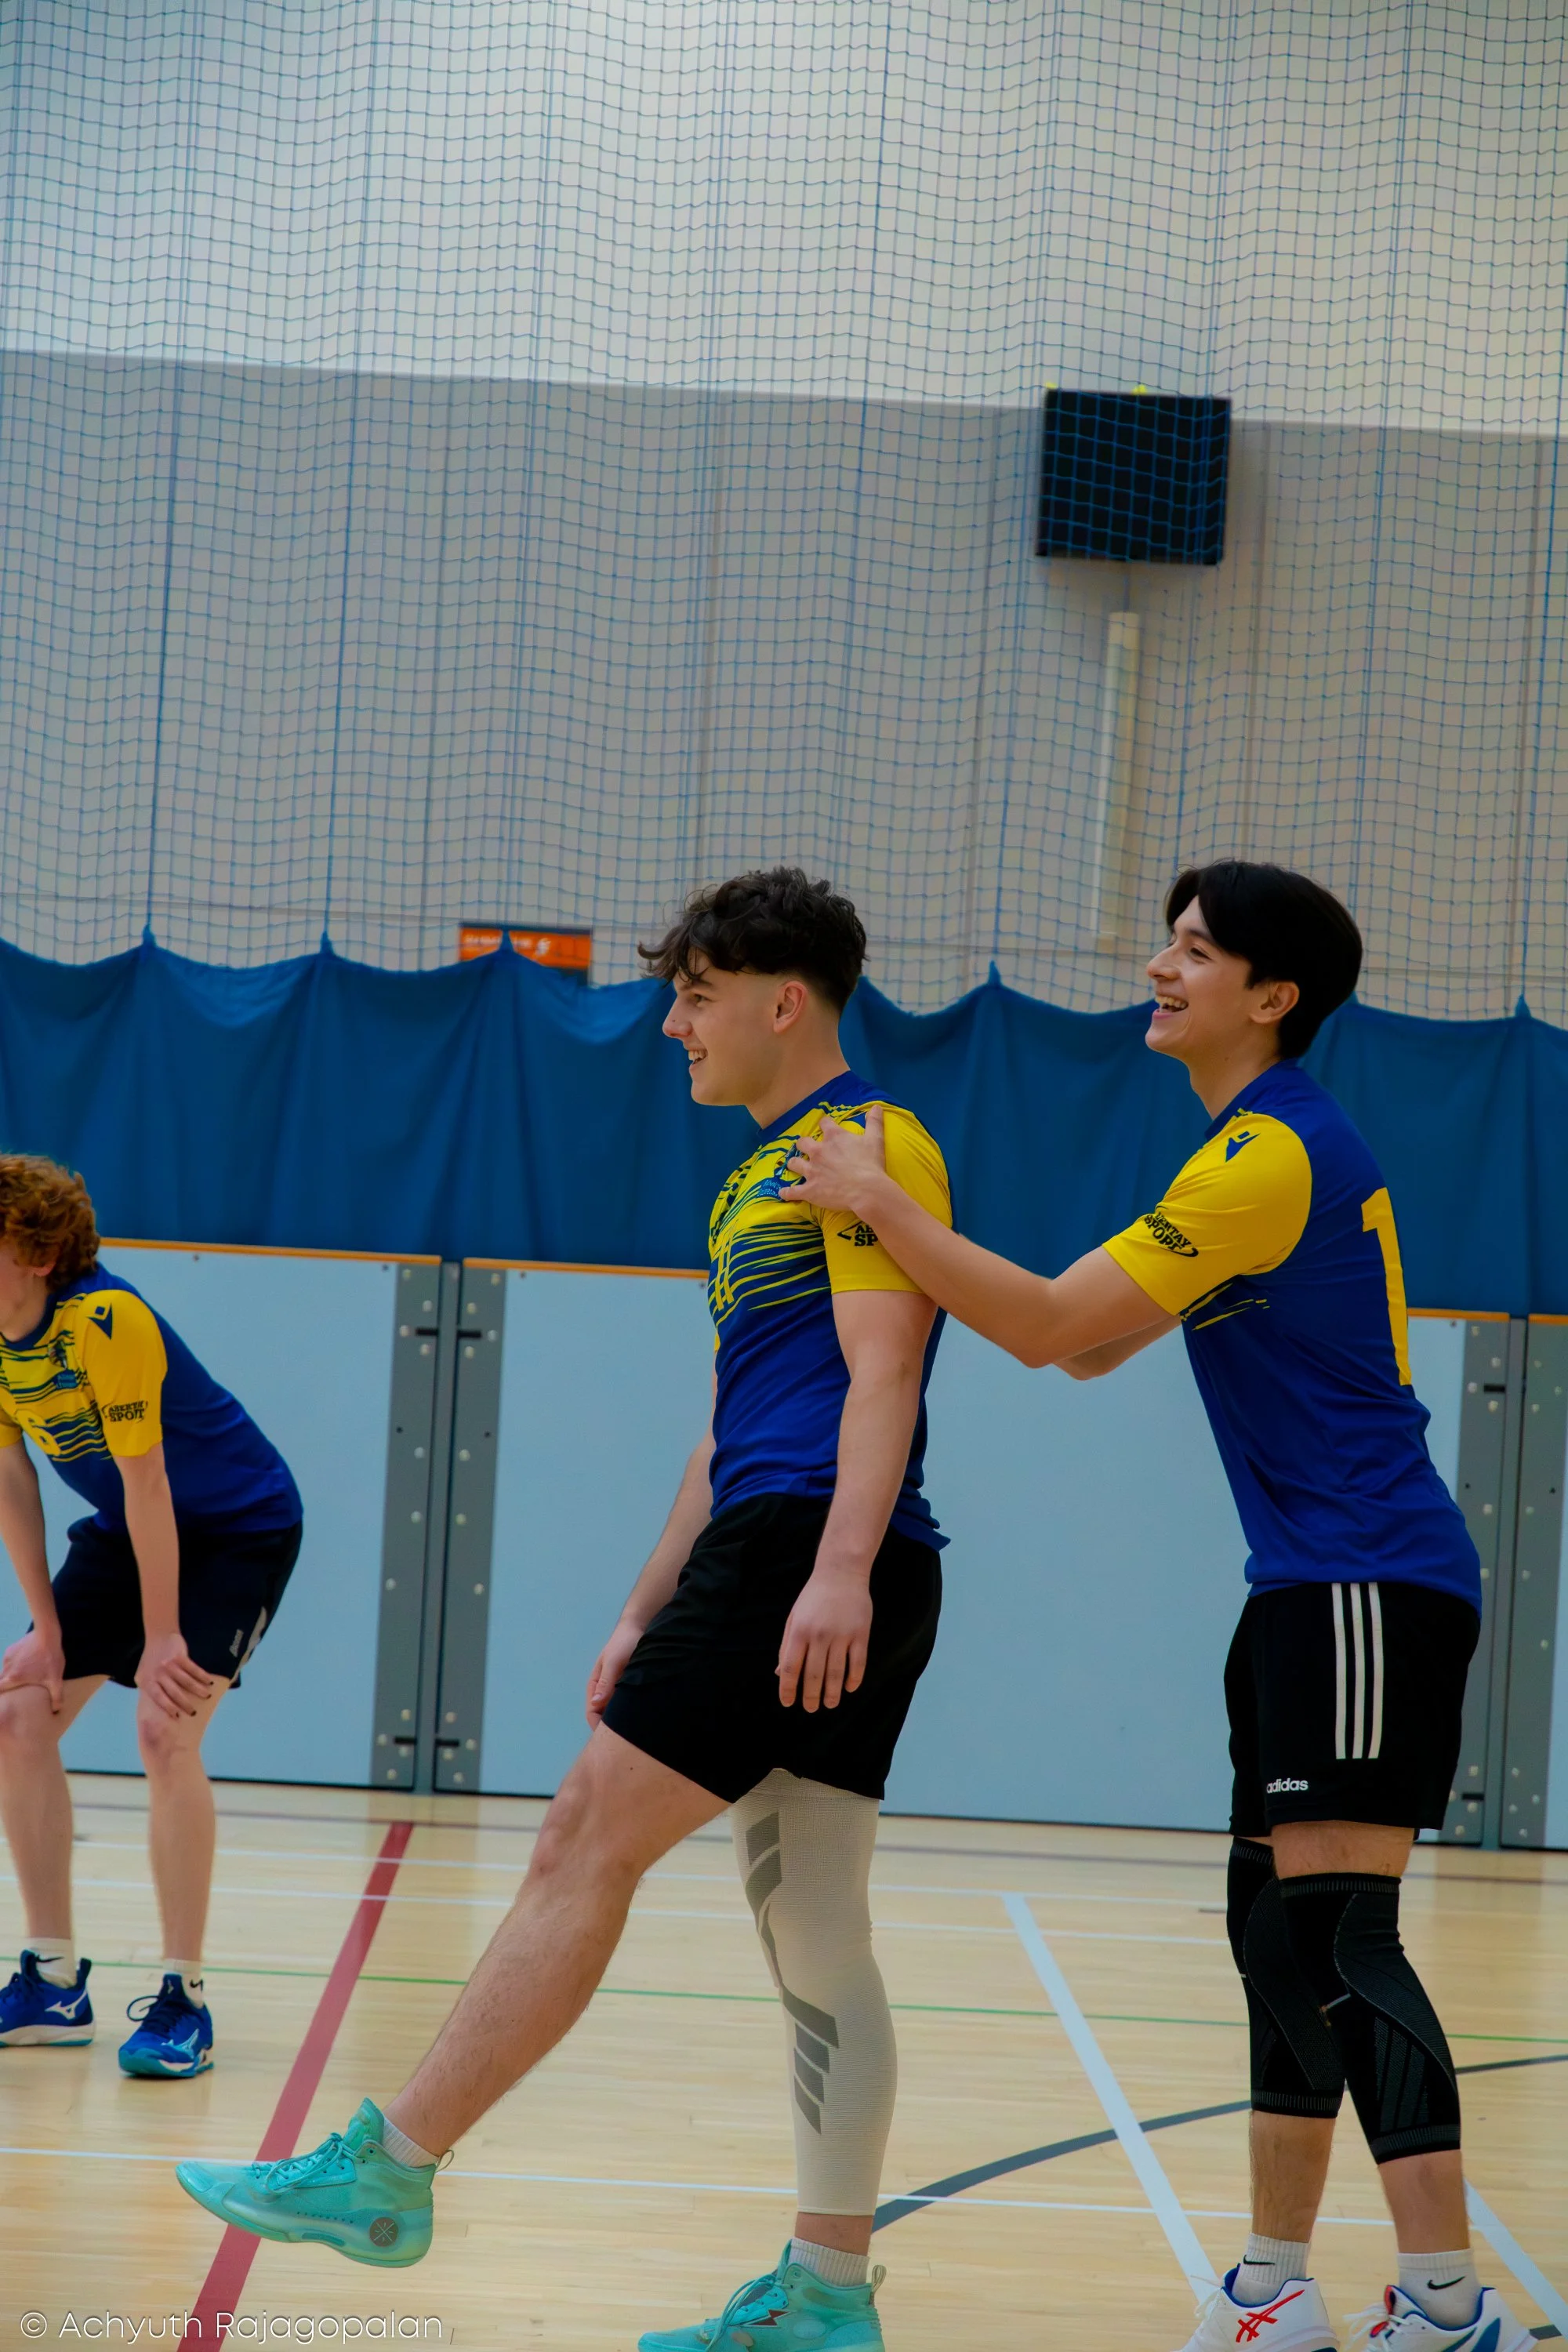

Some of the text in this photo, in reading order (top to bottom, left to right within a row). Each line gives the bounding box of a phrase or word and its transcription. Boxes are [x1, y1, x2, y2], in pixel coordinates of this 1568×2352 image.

[1144, 1214, 1183, 1250] SPORT
[108, 1399, 144, 1413] ABERT
[1266, 1777, 1308, 1794] adidas
